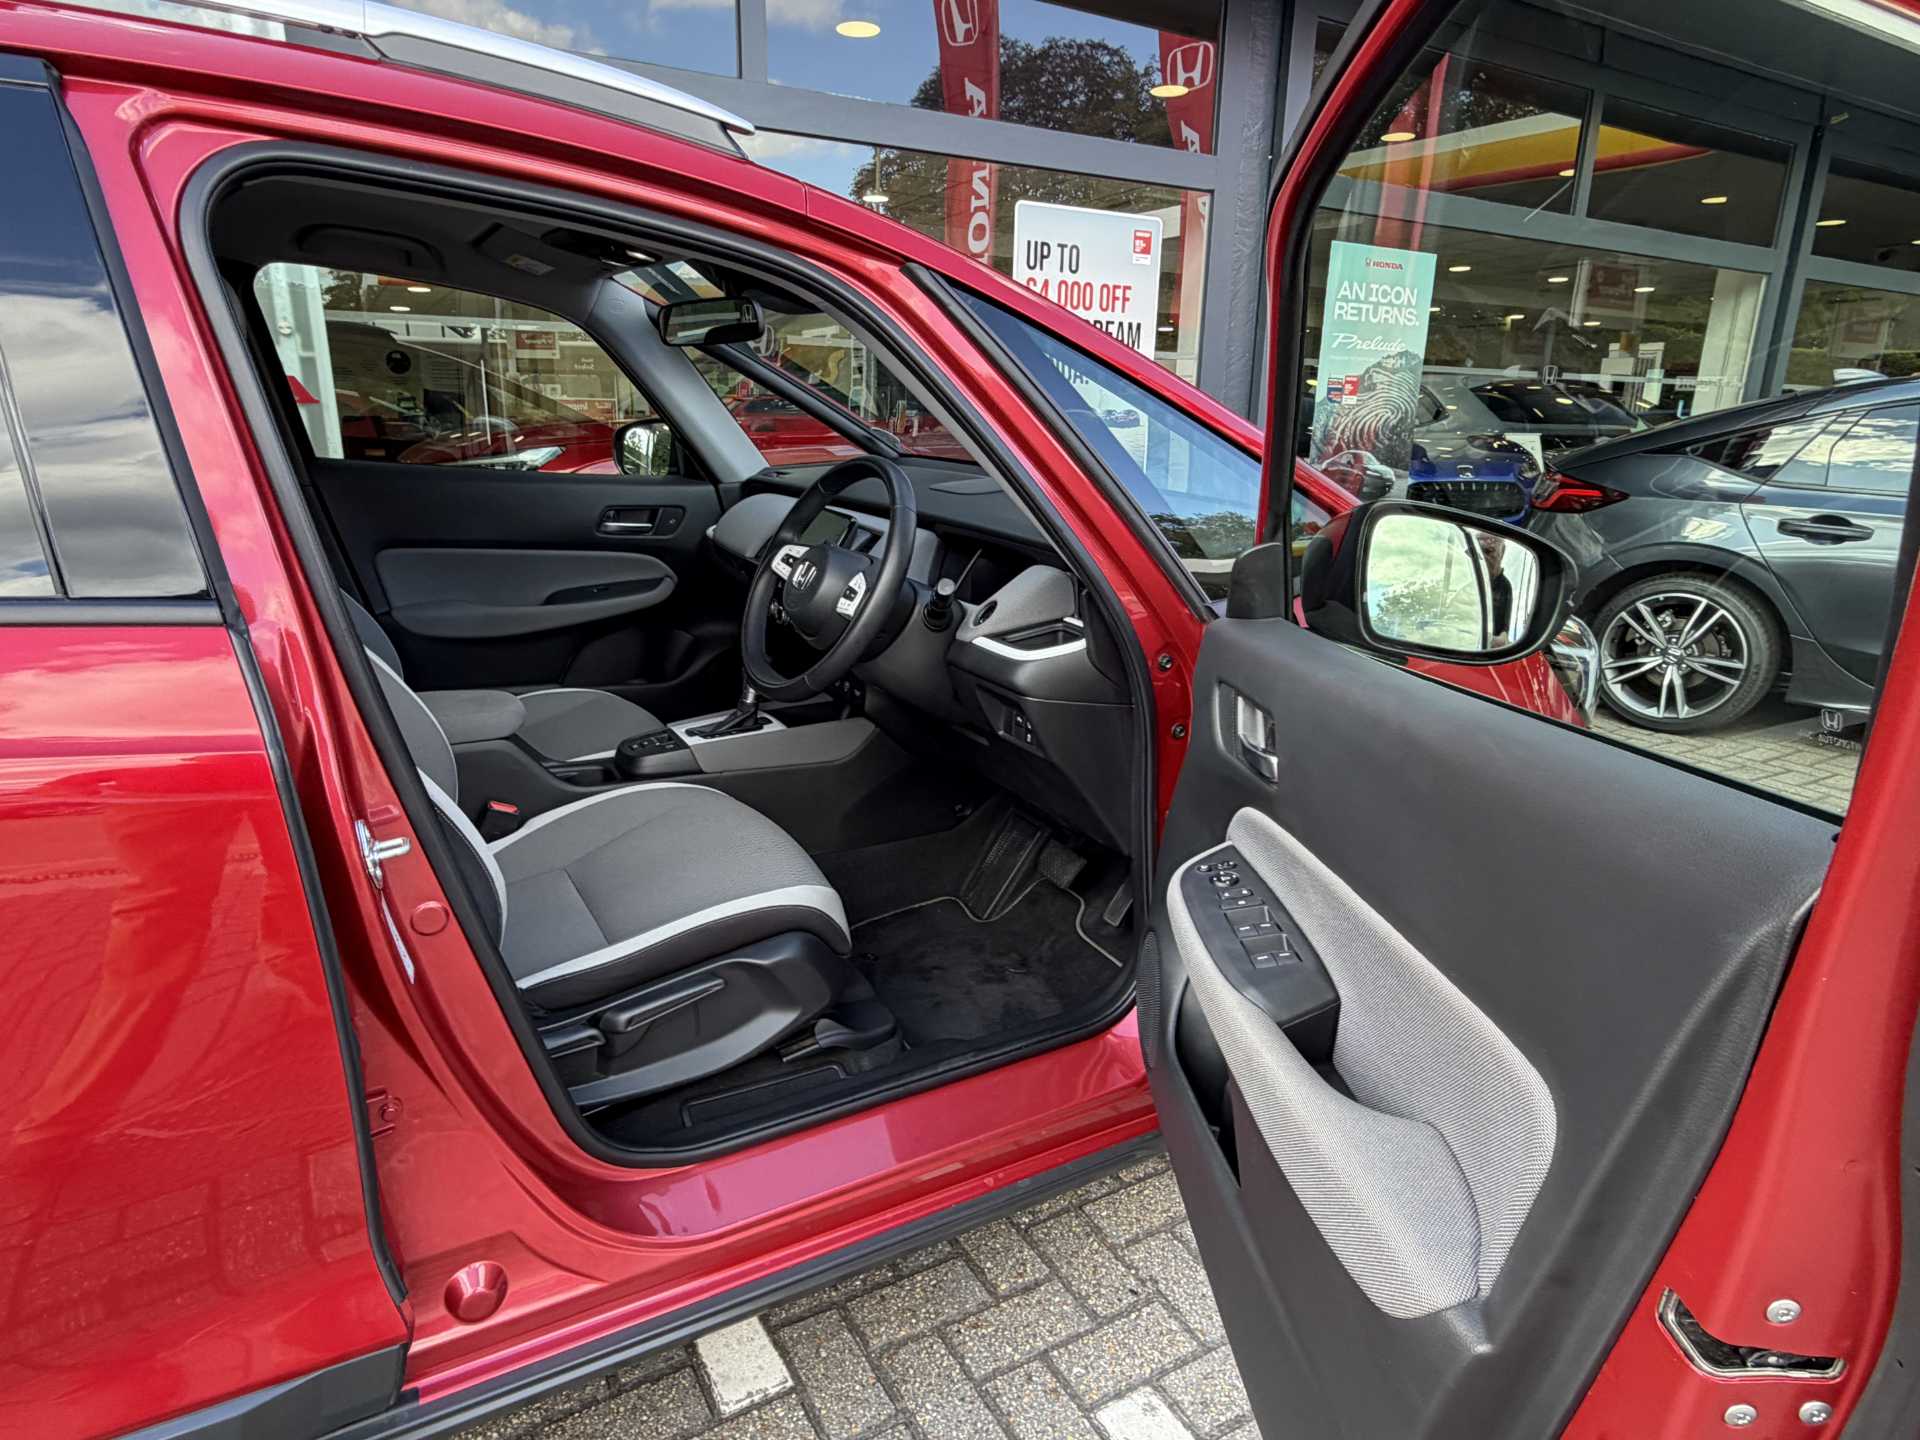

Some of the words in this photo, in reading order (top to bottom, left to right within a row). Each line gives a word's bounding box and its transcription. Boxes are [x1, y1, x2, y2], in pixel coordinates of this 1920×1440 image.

[1026, 240, 1051, 272] UP
[1057, 243, 1080, 274] TO
[1099, 283, 1132, 313] OFF
[1336, 280, 1367, 301] AN
[1368, 283, 1418, 306] ICON
[1334, 301, 1420, 326] RETURNS.
[1330, 332, 1408, 352] Prelude
